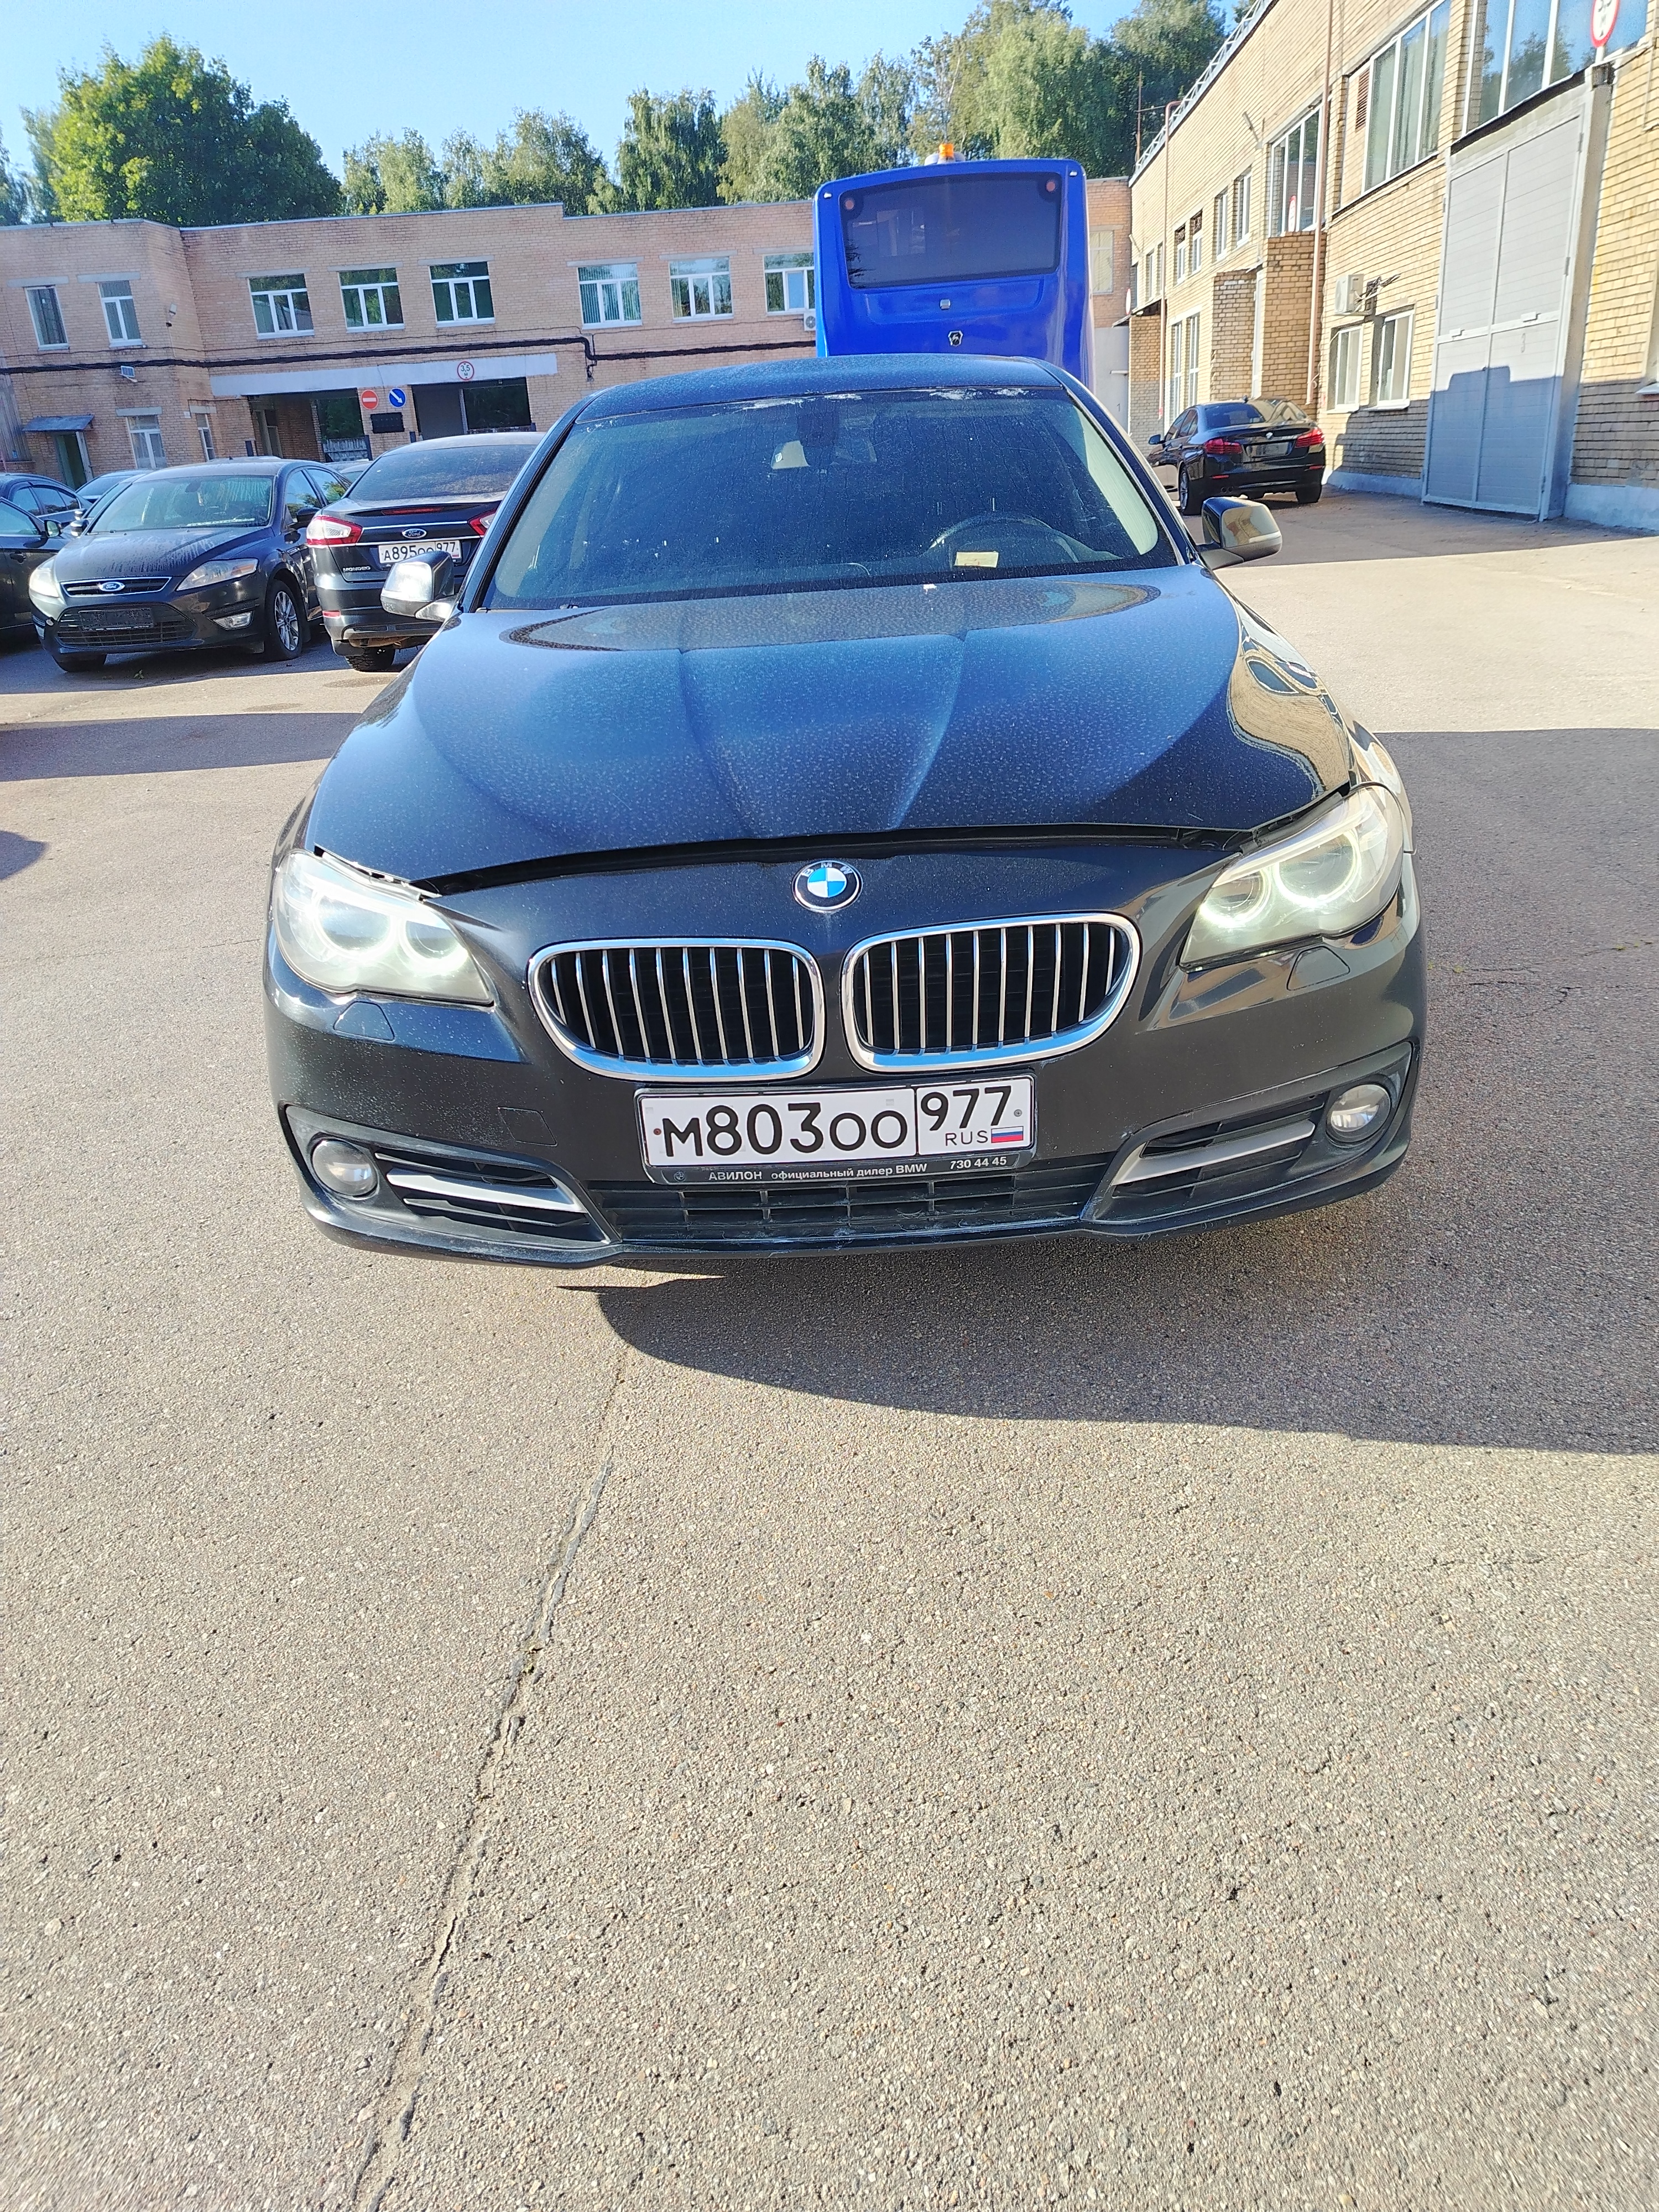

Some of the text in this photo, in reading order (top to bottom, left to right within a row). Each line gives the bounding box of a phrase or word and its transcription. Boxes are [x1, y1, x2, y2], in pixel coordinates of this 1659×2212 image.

[1117, 403, 1120, 412] 1
[436, 542, 456, 552] 977
[801, 862, 853, 877] BMW
[920, 1085, 1012, 1131] 977
[945, 1130, 988, 1146] RUS
[708, 1156, 1007, 1181] АВИЛОН официальный дилер BMW 730 44 45
